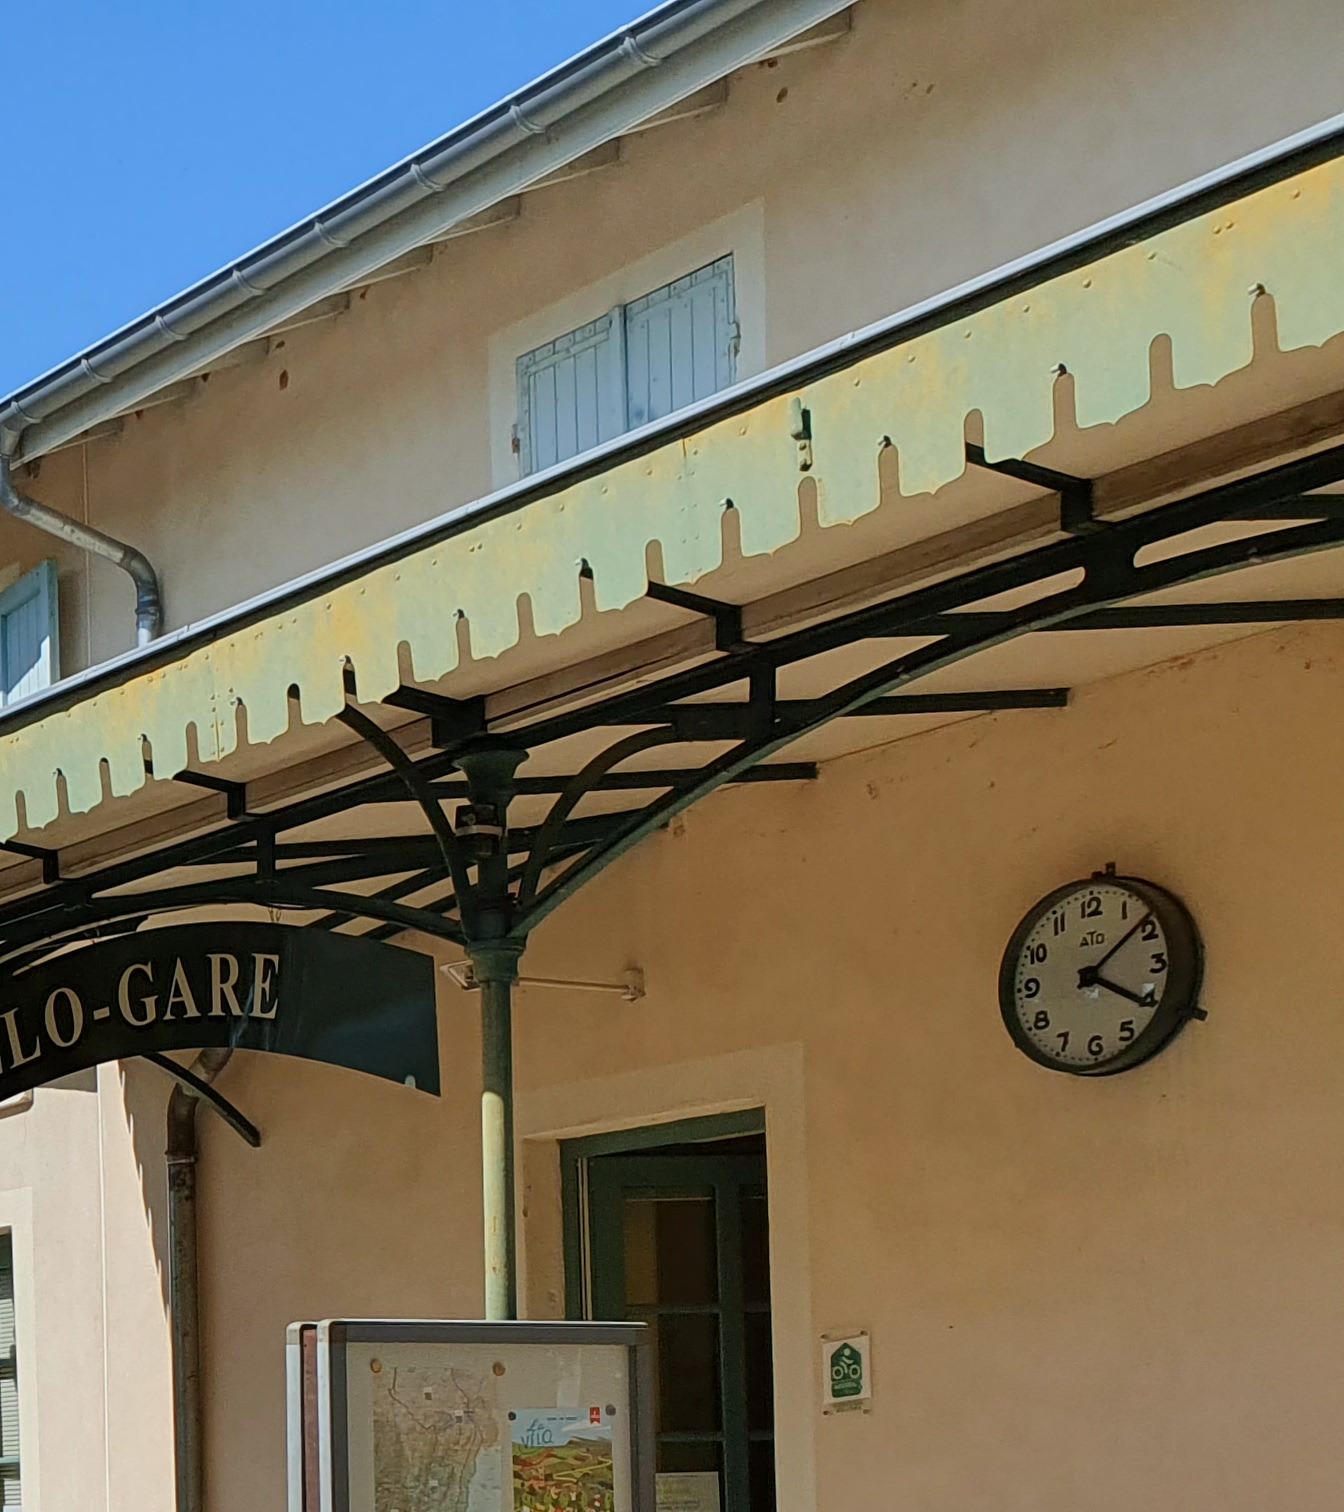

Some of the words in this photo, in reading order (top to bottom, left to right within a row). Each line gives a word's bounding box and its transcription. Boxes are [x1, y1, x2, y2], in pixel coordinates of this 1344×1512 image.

[1081, 896, 1103, 919] 12
[1121, 900, 1128, 920] 1
[1053, 911, 1066, 936] 11
[1141, 919, 1159, 941] 2
[1079, 930, 1105, 948] ATO
[1029, 943, 1048, 965] 10
[1149, 952, 1167, 974] 3
[1024, 977, 1040, 999] 9
[1033, 1010, 1050, 1031] 8
[1118, 1019, 1135, 1042] 5
[1056, 1031, 1070, 1052] 7
[1087, 1035, 1104, 1056] 6
